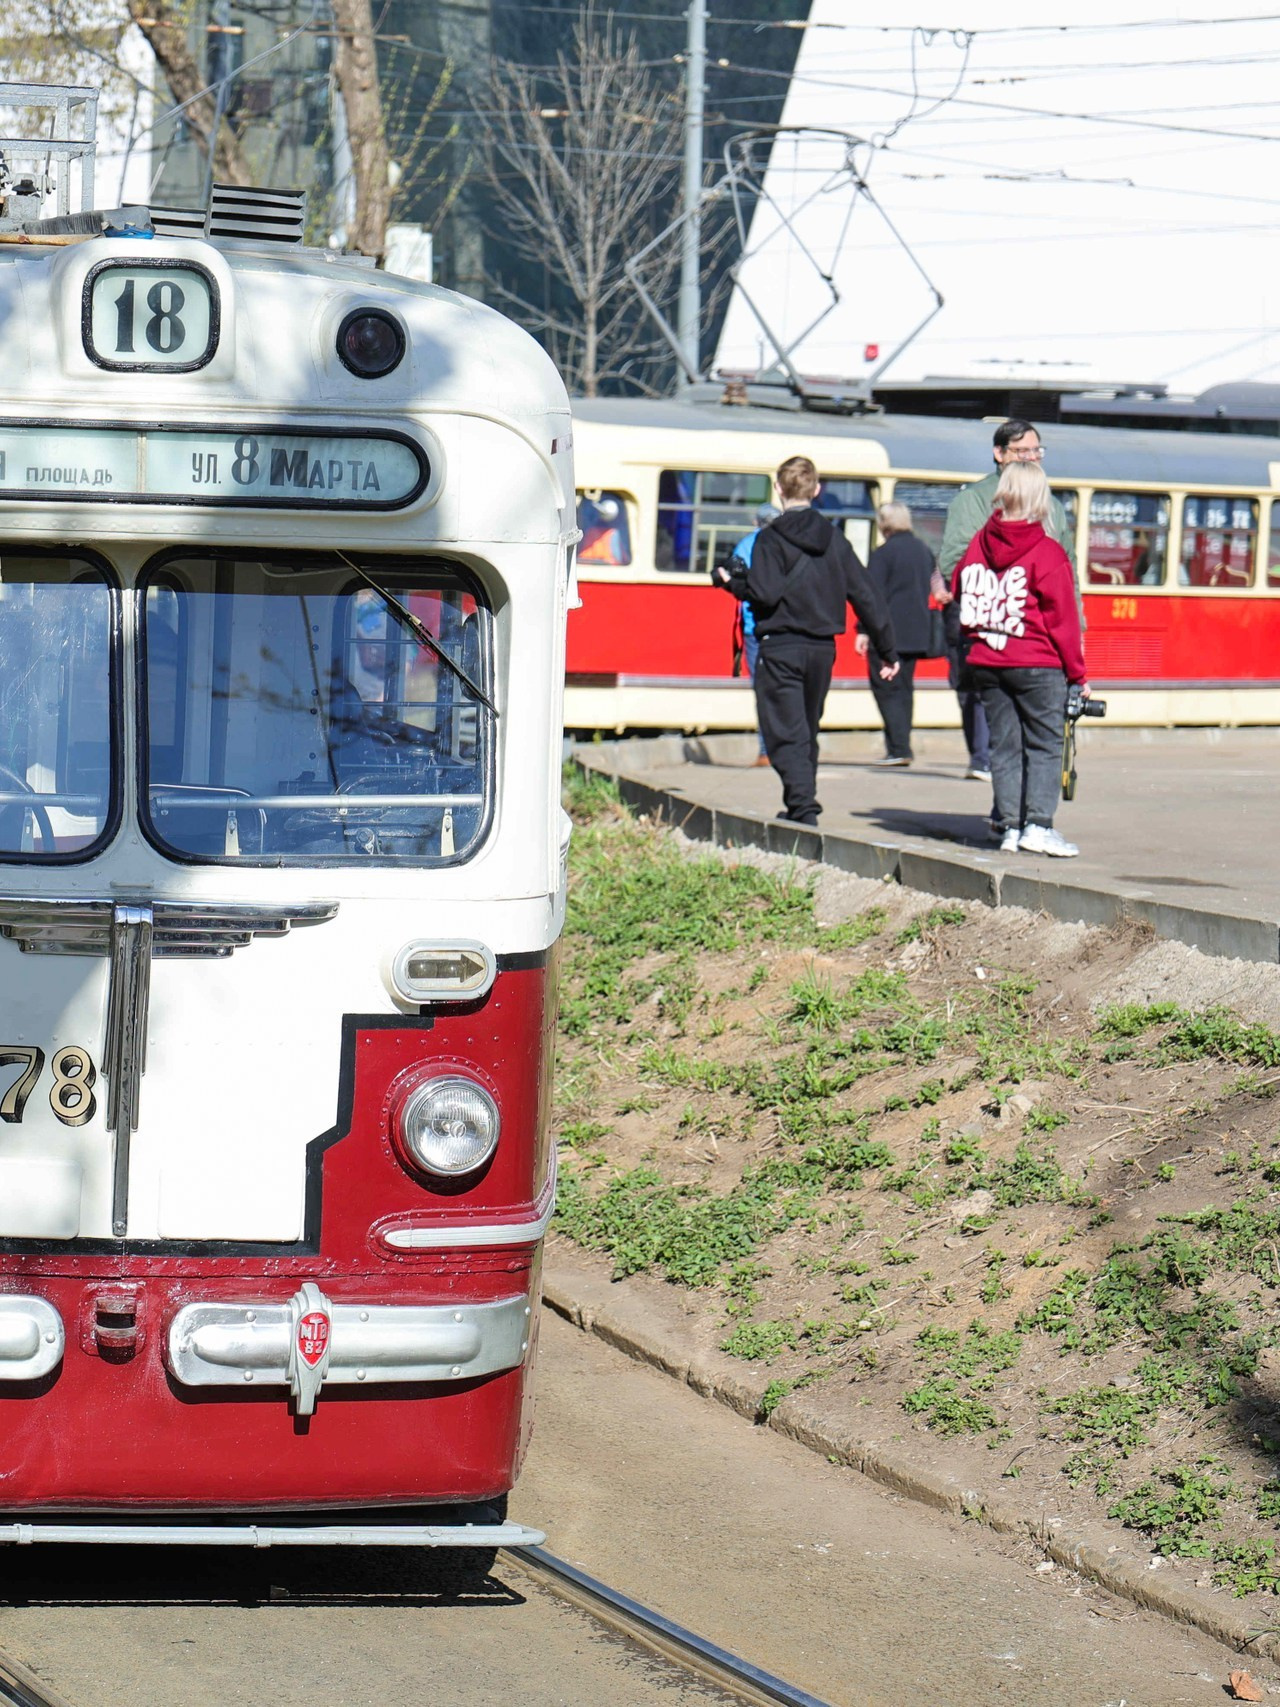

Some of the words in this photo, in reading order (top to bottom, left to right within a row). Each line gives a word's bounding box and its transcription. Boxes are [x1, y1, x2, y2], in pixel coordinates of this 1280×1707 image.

[114, 279, 186, 354] 18
[231, 434, 260, 486] 8
[304, 1340, 323, 1354] 82
